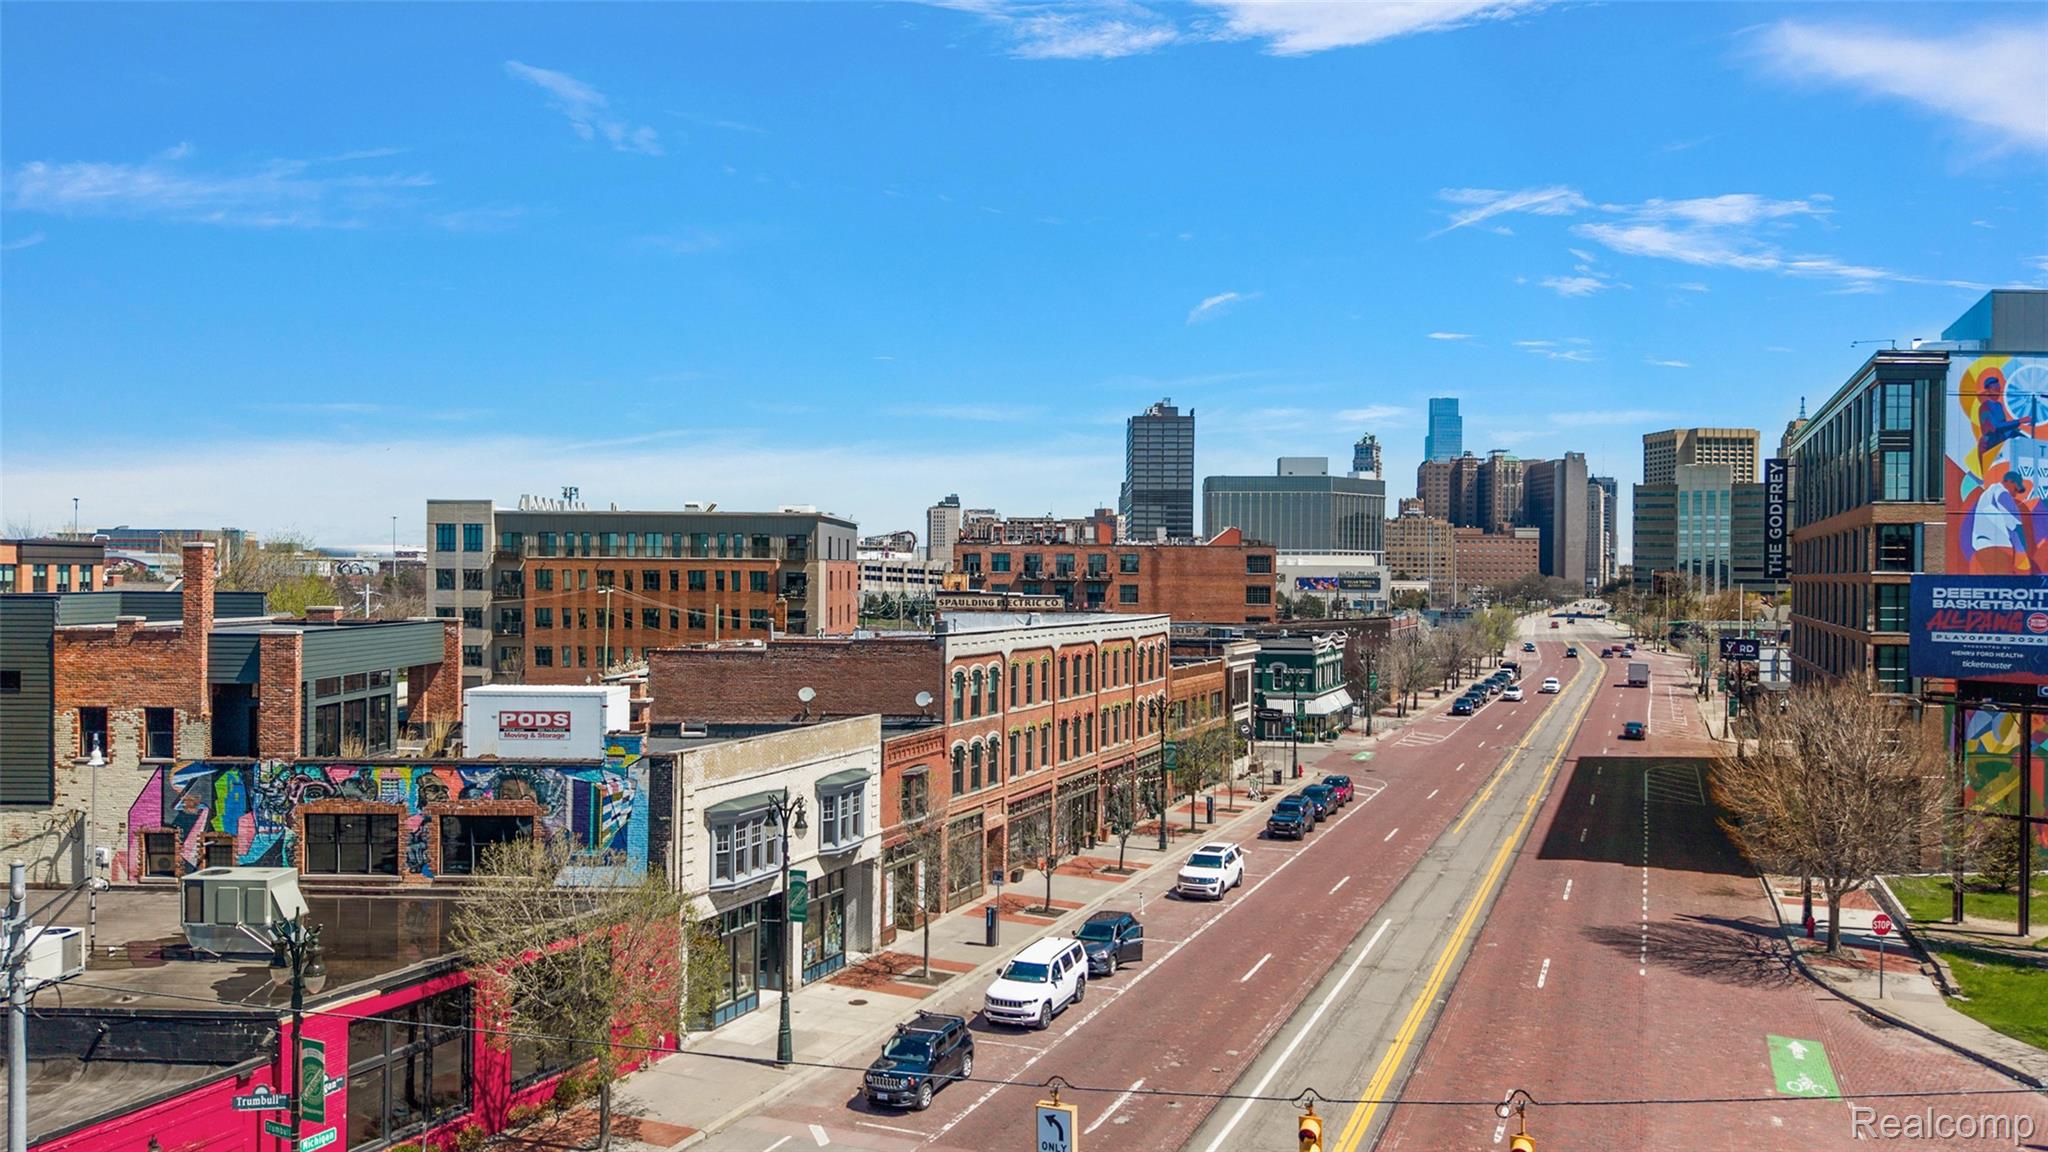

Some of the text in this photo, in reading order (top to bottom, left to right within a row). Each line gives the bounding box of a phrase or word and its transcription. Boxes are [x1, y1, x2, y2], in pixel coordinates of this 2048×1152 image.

[1769, 462, 1784, 575] THE GODFREY
[1932, 587, 2048, 600] DEEETROIT
[939, 599, 994, 607] SPAULDING
[1932, 600, 2048, 611] BASKETBALL
[1962, 660, 2012, 669] ticketmaster
[500, 713, 569, 726] PODS
[1872, 920, 1892, 930] STOP
[236, 1094, 279, 1106] Trumbull
[302, 1130, 335, 1151] Michigan
[1041, 1140, 1067, 1152] ONLY
